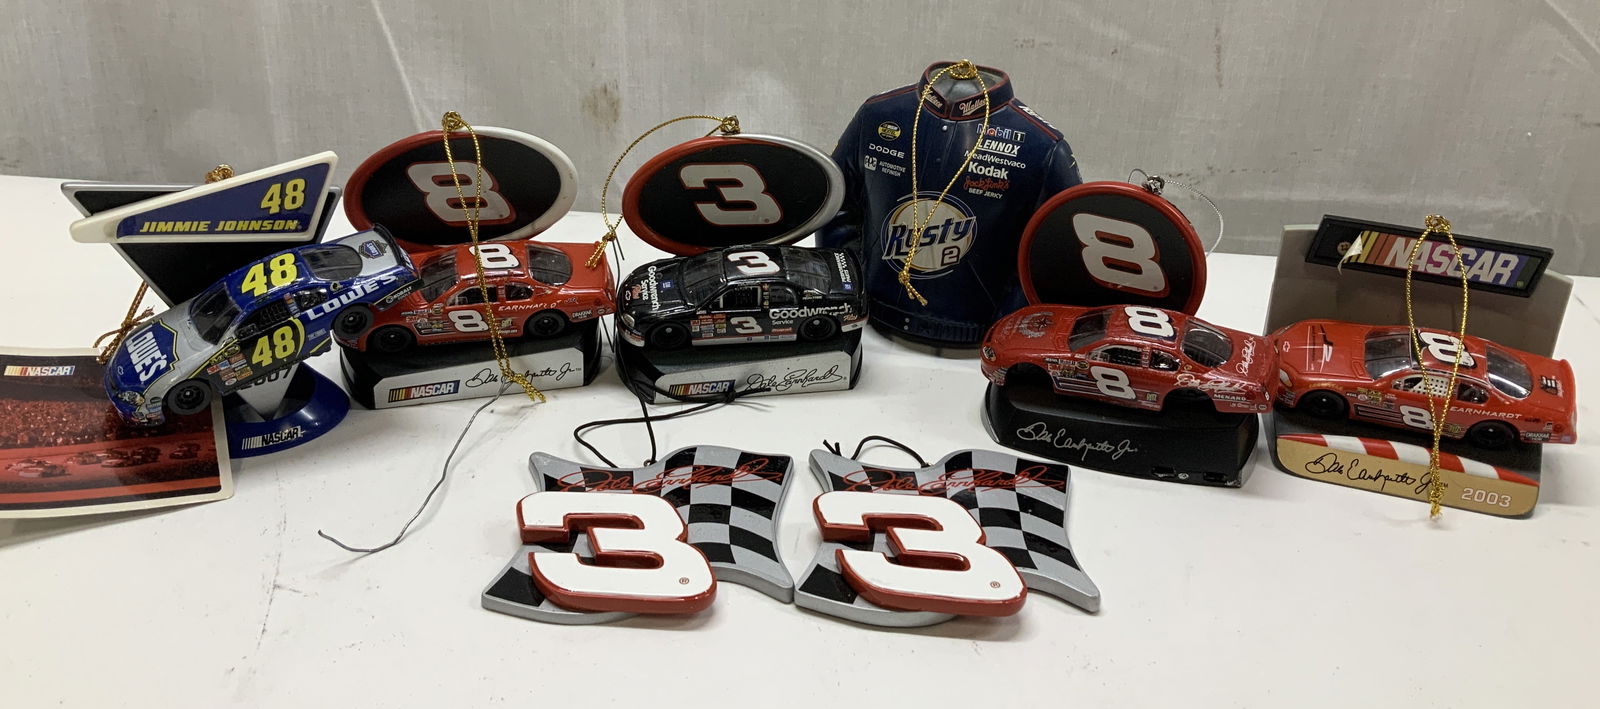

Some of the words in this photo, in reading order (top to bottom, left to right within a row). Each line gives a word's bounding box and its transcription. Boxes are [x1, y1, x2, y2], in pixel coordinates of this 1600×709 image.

[977, 123, 1012, 140] Mobil
[869, 143, 905, 159] DODGE
[977, 139, 1021, 155] LENNOX
[968, 161, 1009, 180] Kodak
[260, 178, 306, 215] 48
[406, 161, 515, 225] 8
[679, 163, 783, 226] 3
[968, 187, 984, 195] BEEF
[984, 190, 1003, 199] JERKY
[139, 220, 211, 233] JIMMIE
[215, 219, 299, 232] JOHNSON
[882, 216, 976, 259] Rusty
[469, 243, 520, 269] 8
[727, 250, 780, 275] 3
[941, 246, 960, 267] 2
[1072, 212, 1169, 297] 8
[1384, 236, 1519, 285] NASCAR
[241, 252, 298, 297] 48
[305, 273, 398, 321] LOWE'S
[448, 310, 489, 332] 8
[729, 316, 763, 334] 3
[1124, 306, 1175, 338] 8
[125, 325, 167, 382] LOWE'S
[251, 325, 296, 367] 48
[1419, 332, 1475, 367] 8
[25, 366, 73, 376] NASCAR
[1089, 365, 1136, 399] 8
[410, 381, 455, 399] NASCAR
[688, 381, 729, 395] NASCAR
[1400, 405, 1436, 430] 8
[1450, 406, 1522, 420] EARNHARDT
[1461, 487, 1512, 508] 2003
[517, 490, 717, 608] 3
[813, 490, 1026, 612] 3
